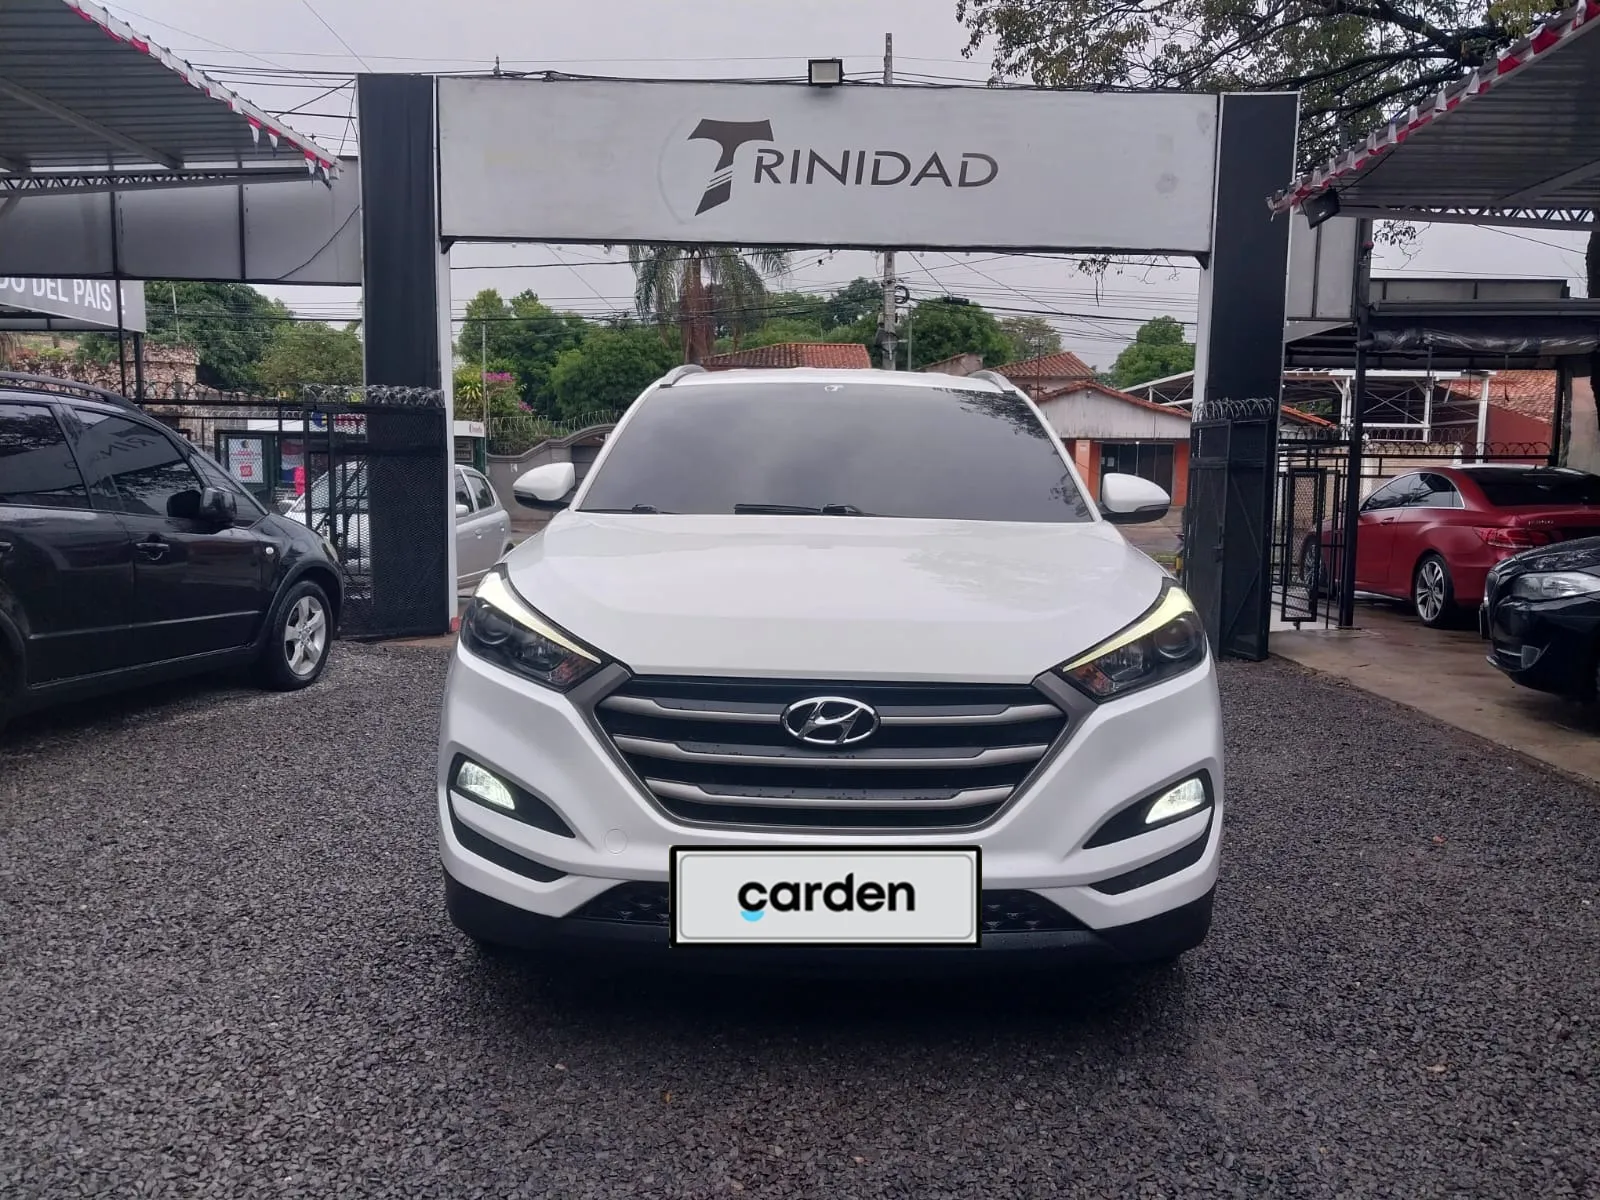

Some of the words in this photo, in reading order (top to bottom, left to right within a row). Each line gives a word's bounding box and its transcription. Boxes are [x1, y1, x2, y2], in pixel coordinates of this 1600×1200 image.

[687, 118, 999, 216] TRINIDAD
[32, 278, 69, 303] DEL
[72, 279, 112, 312] PAIS
